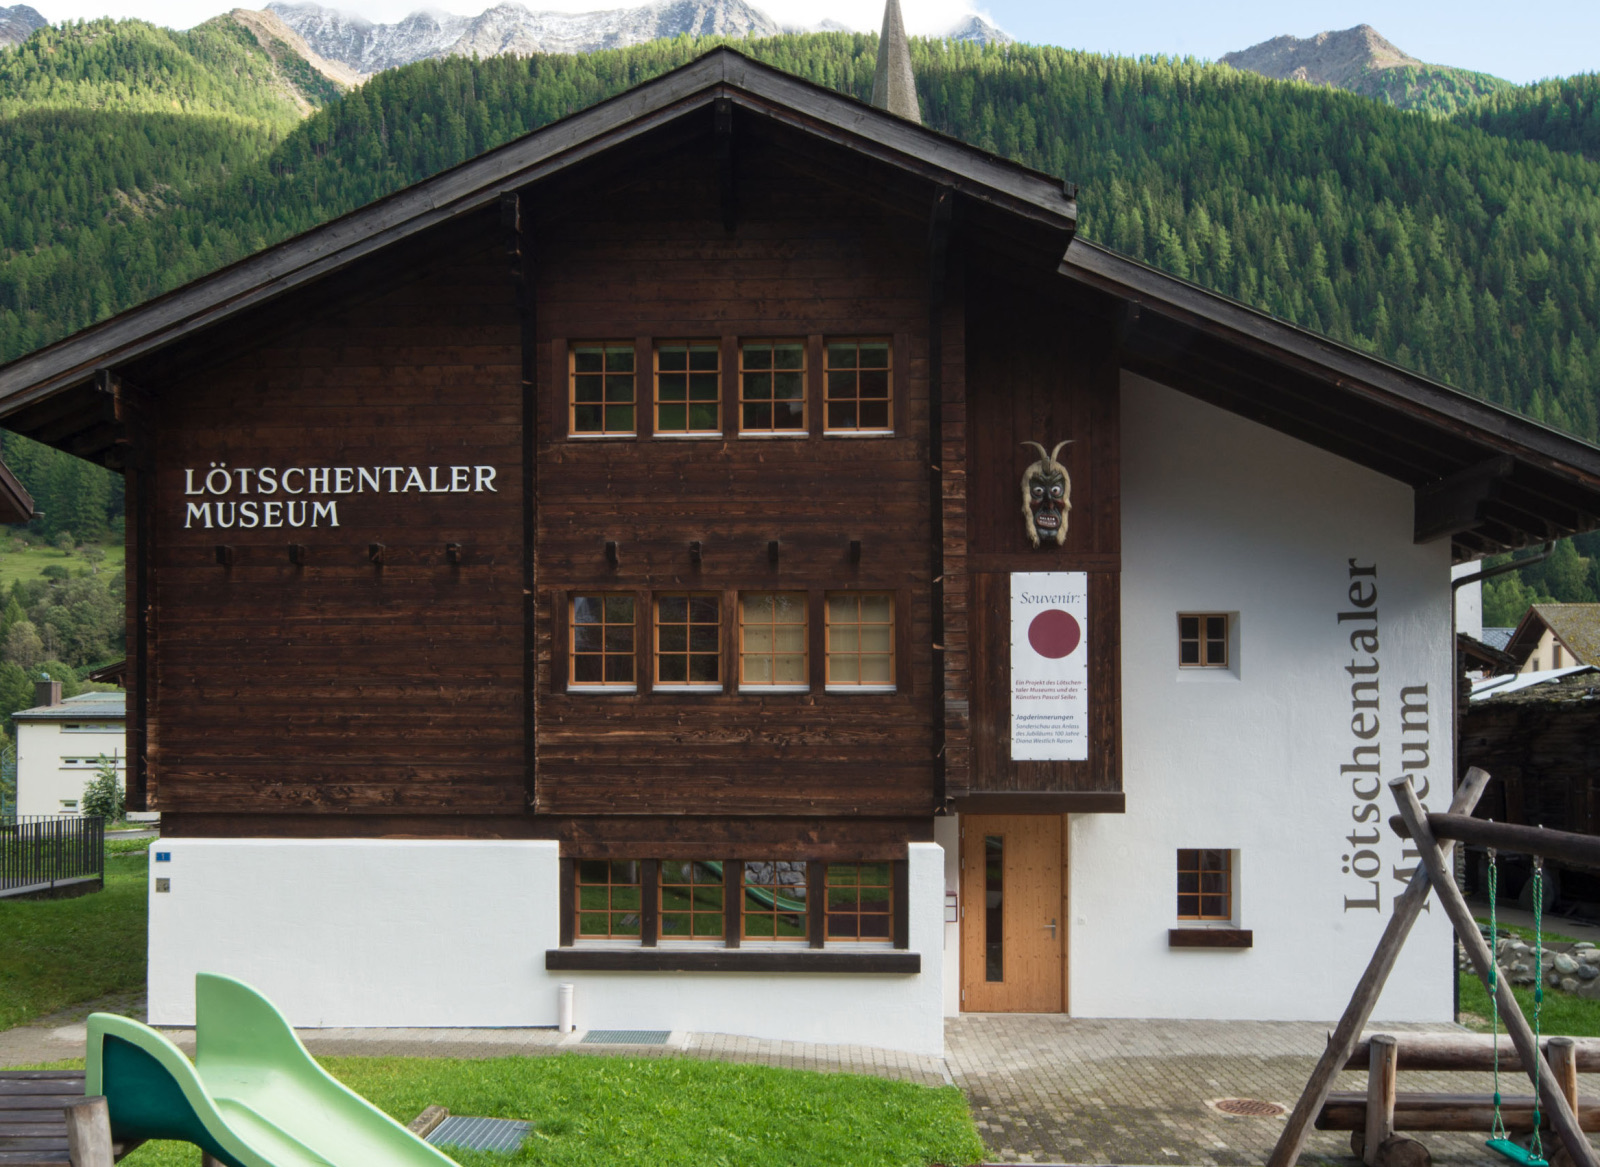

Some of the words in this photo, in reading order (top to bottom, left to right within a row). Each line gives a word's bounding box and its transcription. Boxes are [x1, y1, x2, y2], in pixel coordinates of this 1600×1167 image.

[184, 461, 498, 494] LÖTSCHENTALER
[184, 501, 340, 528] MUSEUM
[1020, 591, 1081, 604] Souvenir:
[1015, 714, 1074, 722] Jagderinnerungen
[1337, 558, 1381, 914] Lötschentaler
